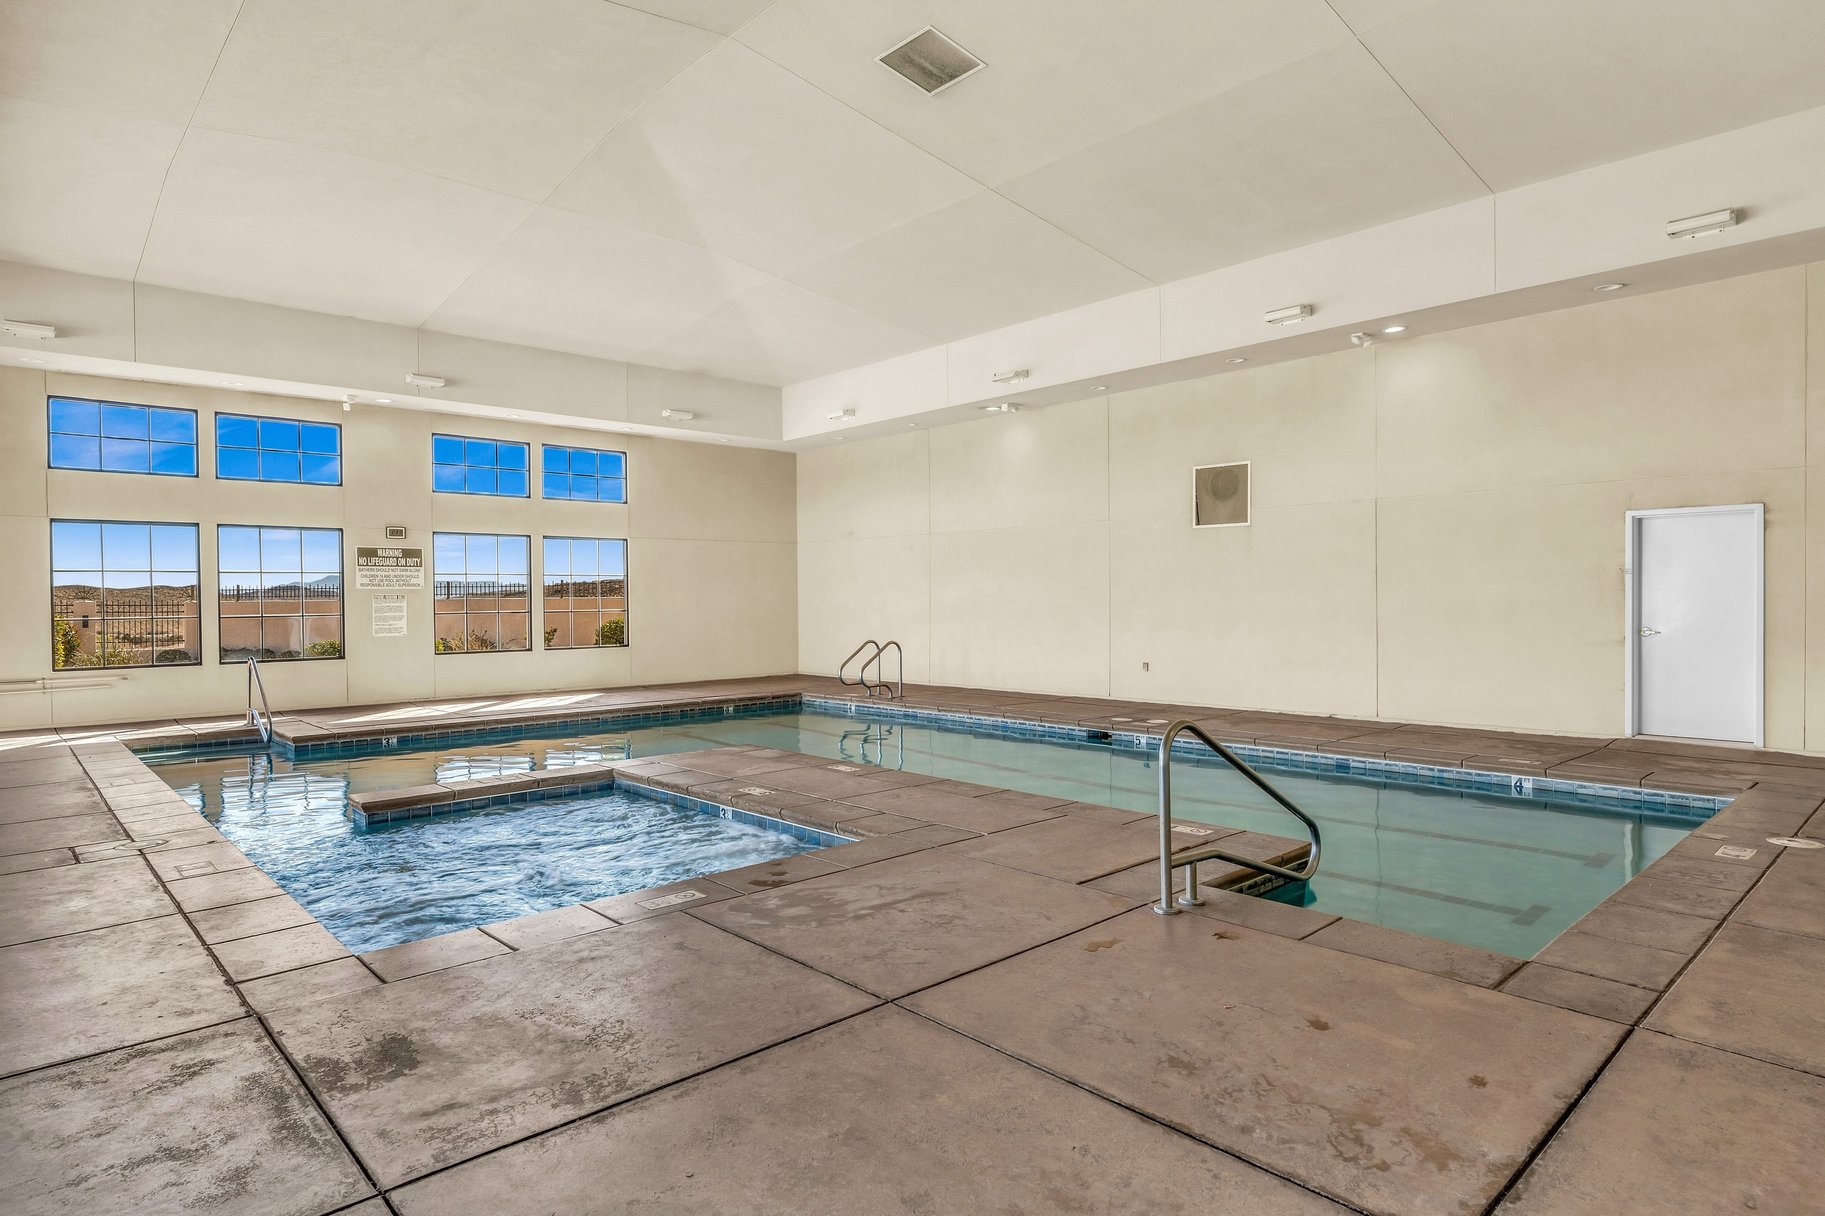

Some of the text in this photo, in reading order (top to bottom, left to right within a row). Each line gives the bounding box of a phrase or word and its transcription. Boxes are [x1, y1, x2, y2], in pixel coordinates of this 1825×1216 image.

[377, 549, 402, 557] WARNING
[358, 557, 366, 565] NO
[368, 558, 397, 566] LIFEGUARD
[407, 558, 420, 566] DUTY
[1136, 736, 1141, 745] 5
[1514, 778, 1523, 788] 4
